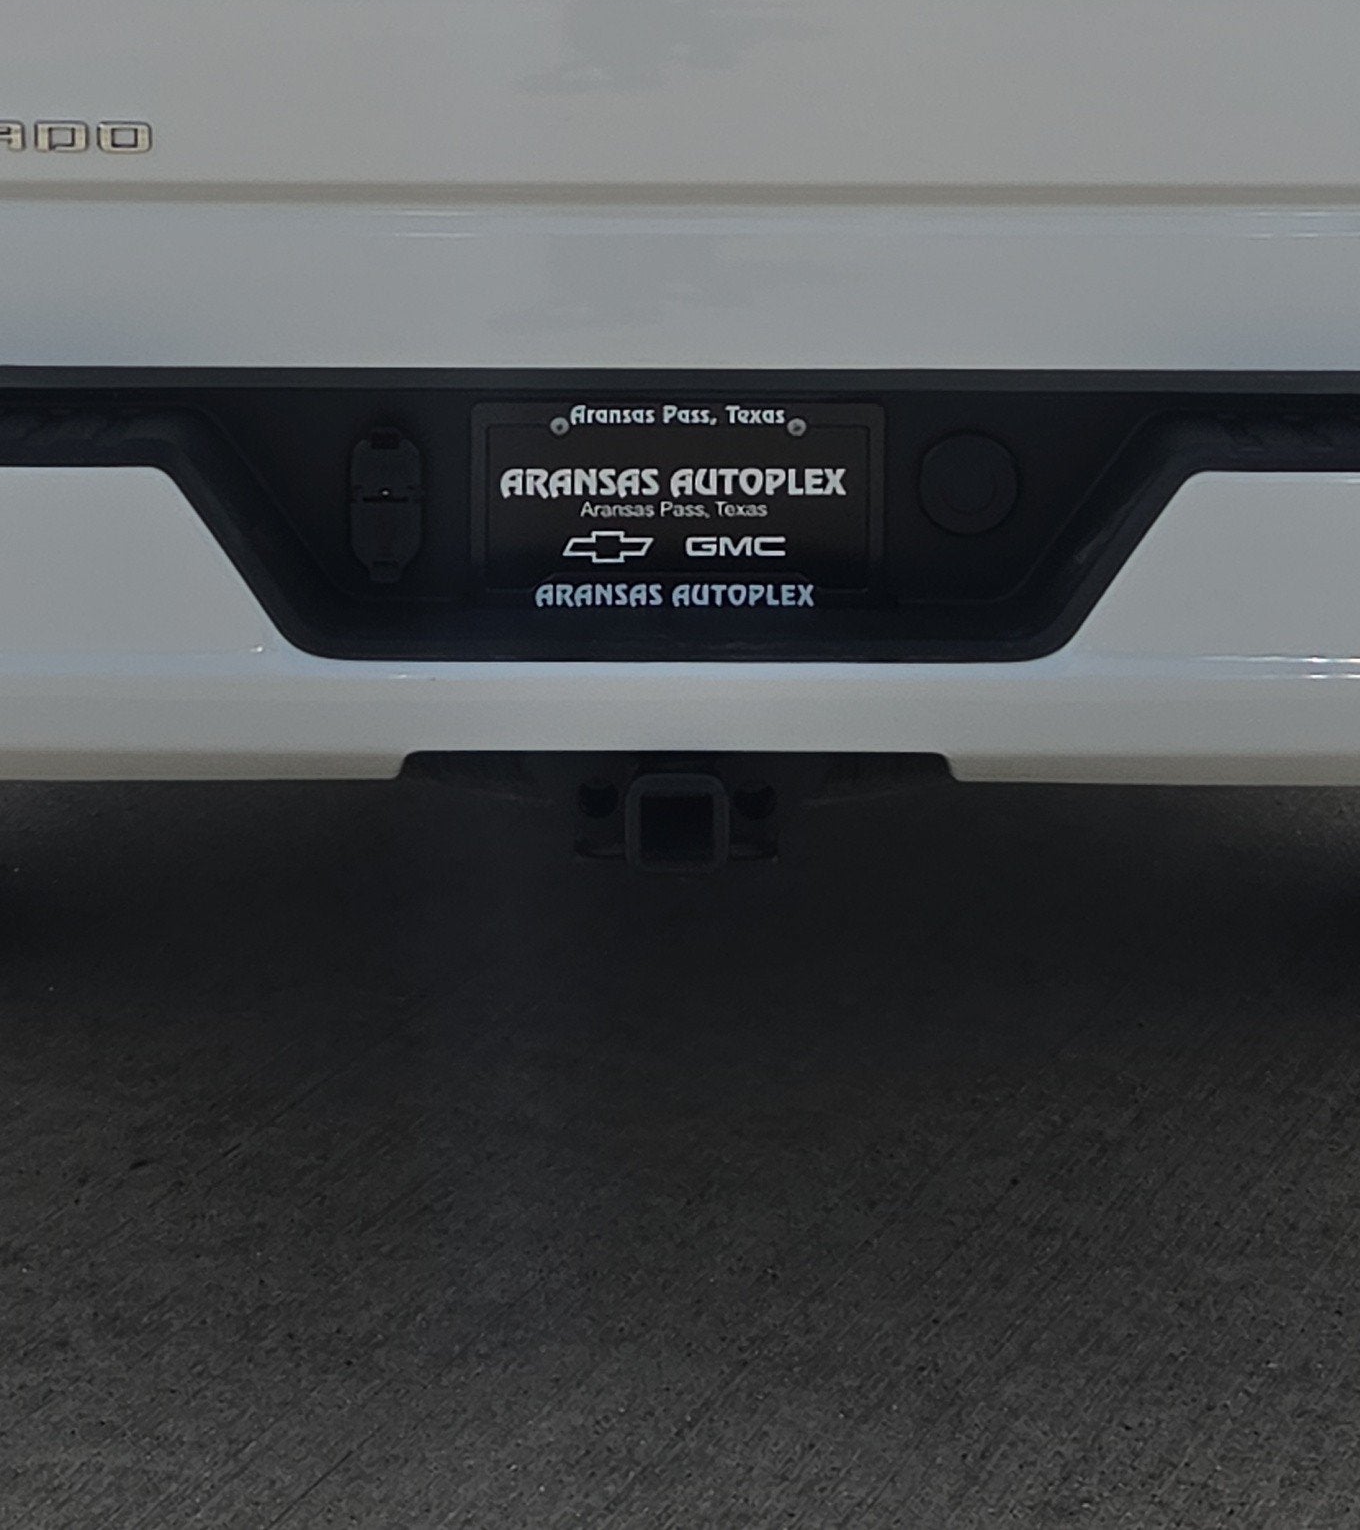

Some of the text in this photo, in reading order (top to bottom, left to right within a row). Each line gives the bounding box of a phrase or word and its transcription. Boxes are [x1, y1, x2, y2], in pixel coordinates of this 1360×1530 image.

[569, 405, 786, 426] Aransas Pass, Texas
[500, 468, 847, 499] ARANSAS AUTOPLEX
[580, 501, 769, 520] Aransas Pass, Texas
[685, 536, 787, 557] GMC
[534, 583, 816, 608] ARANSAS AUTOPLEX
